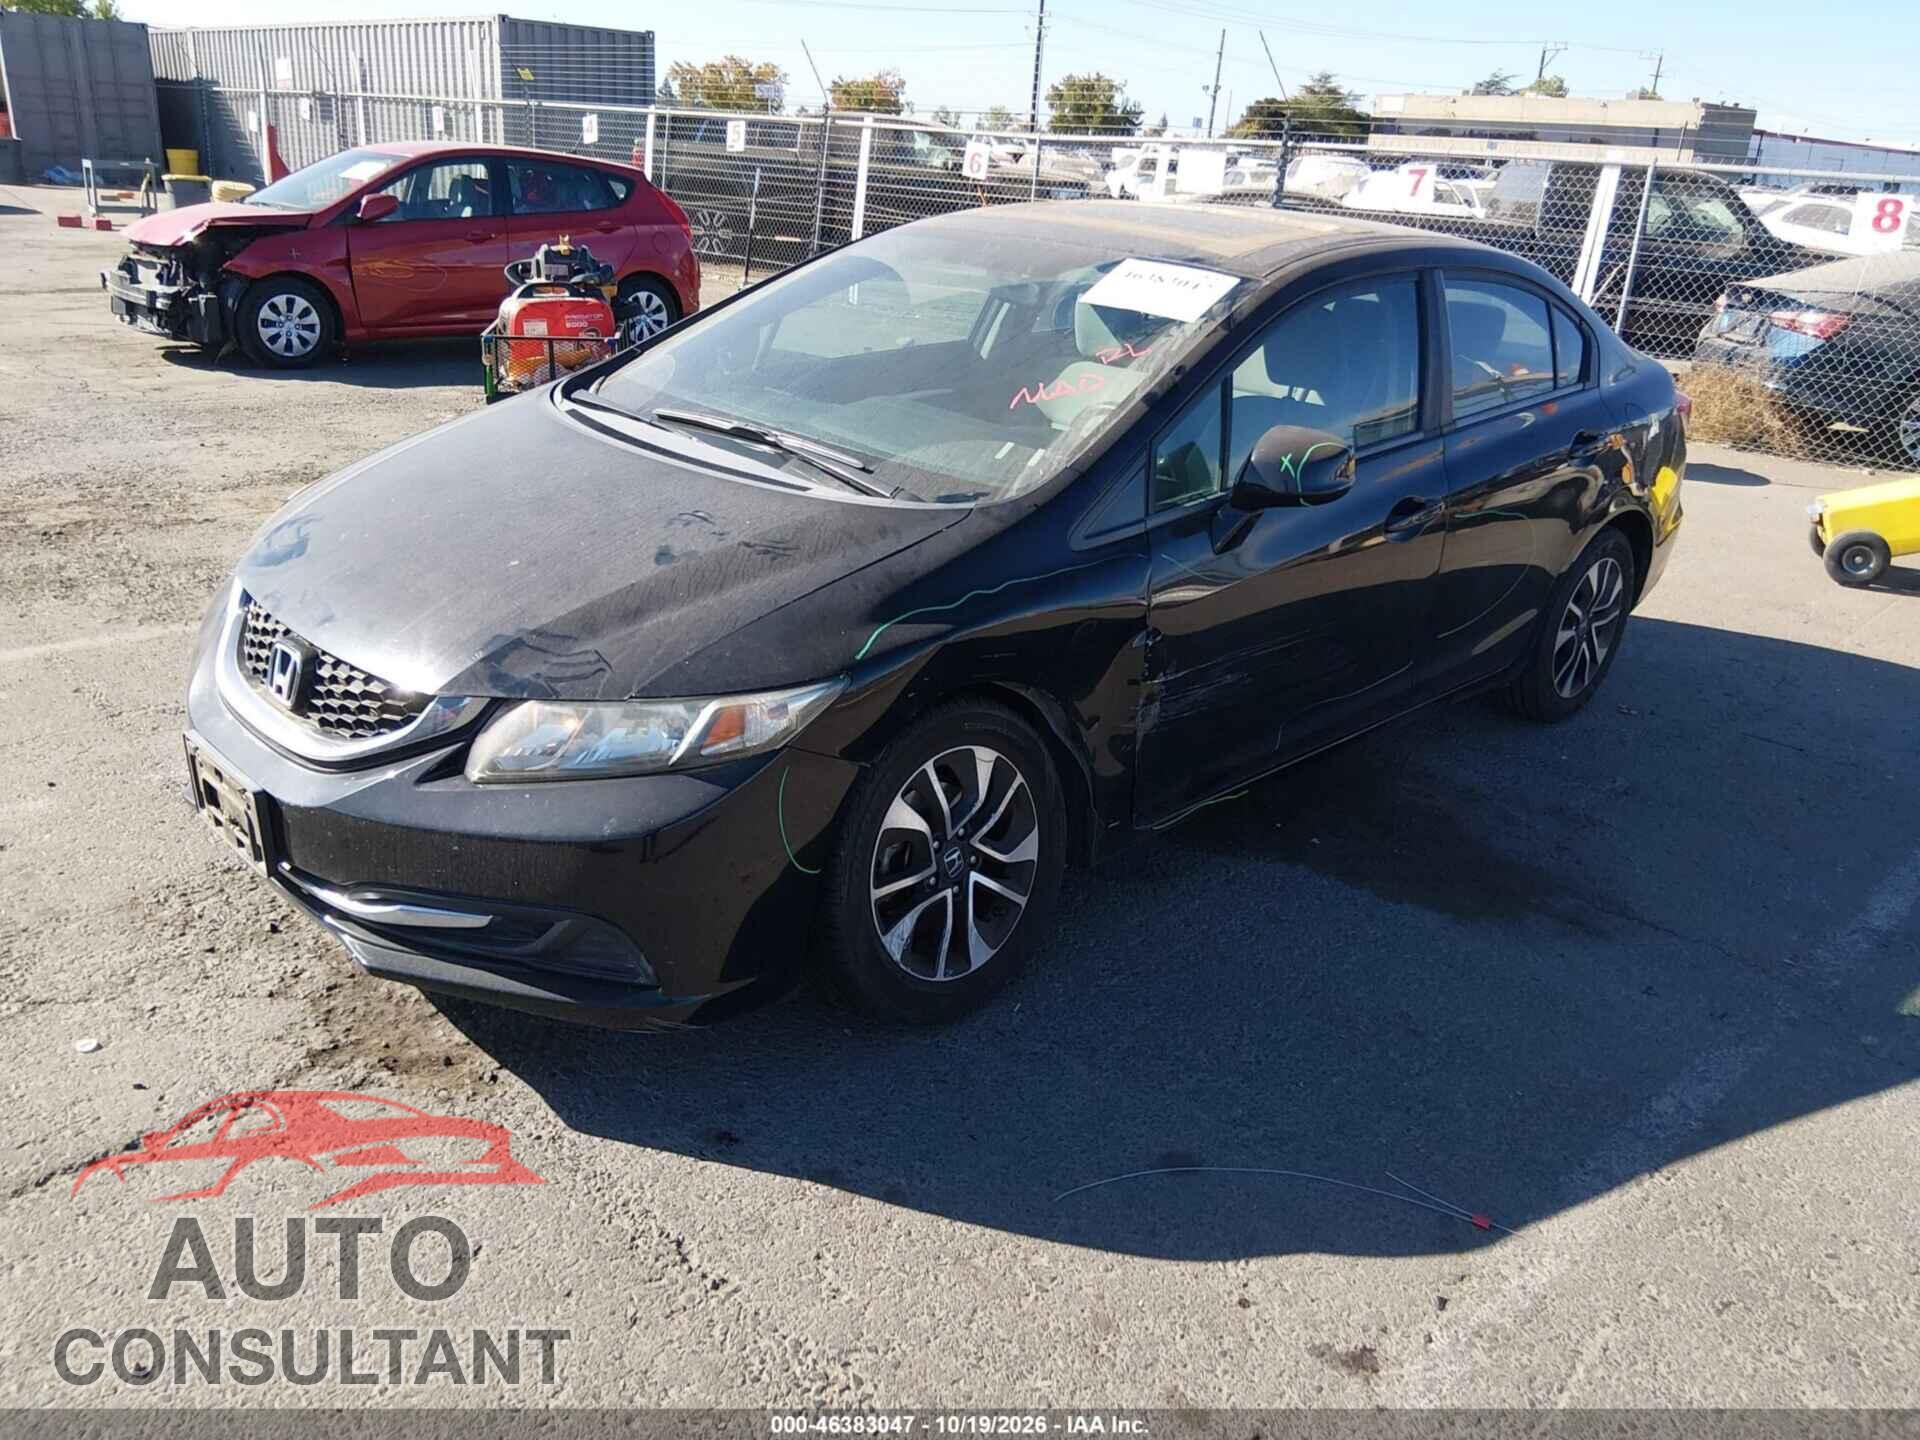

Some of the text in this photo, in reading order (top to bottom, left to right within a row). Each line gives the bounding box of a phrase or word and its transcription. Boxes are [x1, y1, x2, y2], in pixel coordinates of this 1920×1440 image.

[732, 124, 741, 144] 5
[969, 152, 983, 175] 6
[1408, 168, 1428, 197] 7
[1872, 197, 1904, 233] 8
